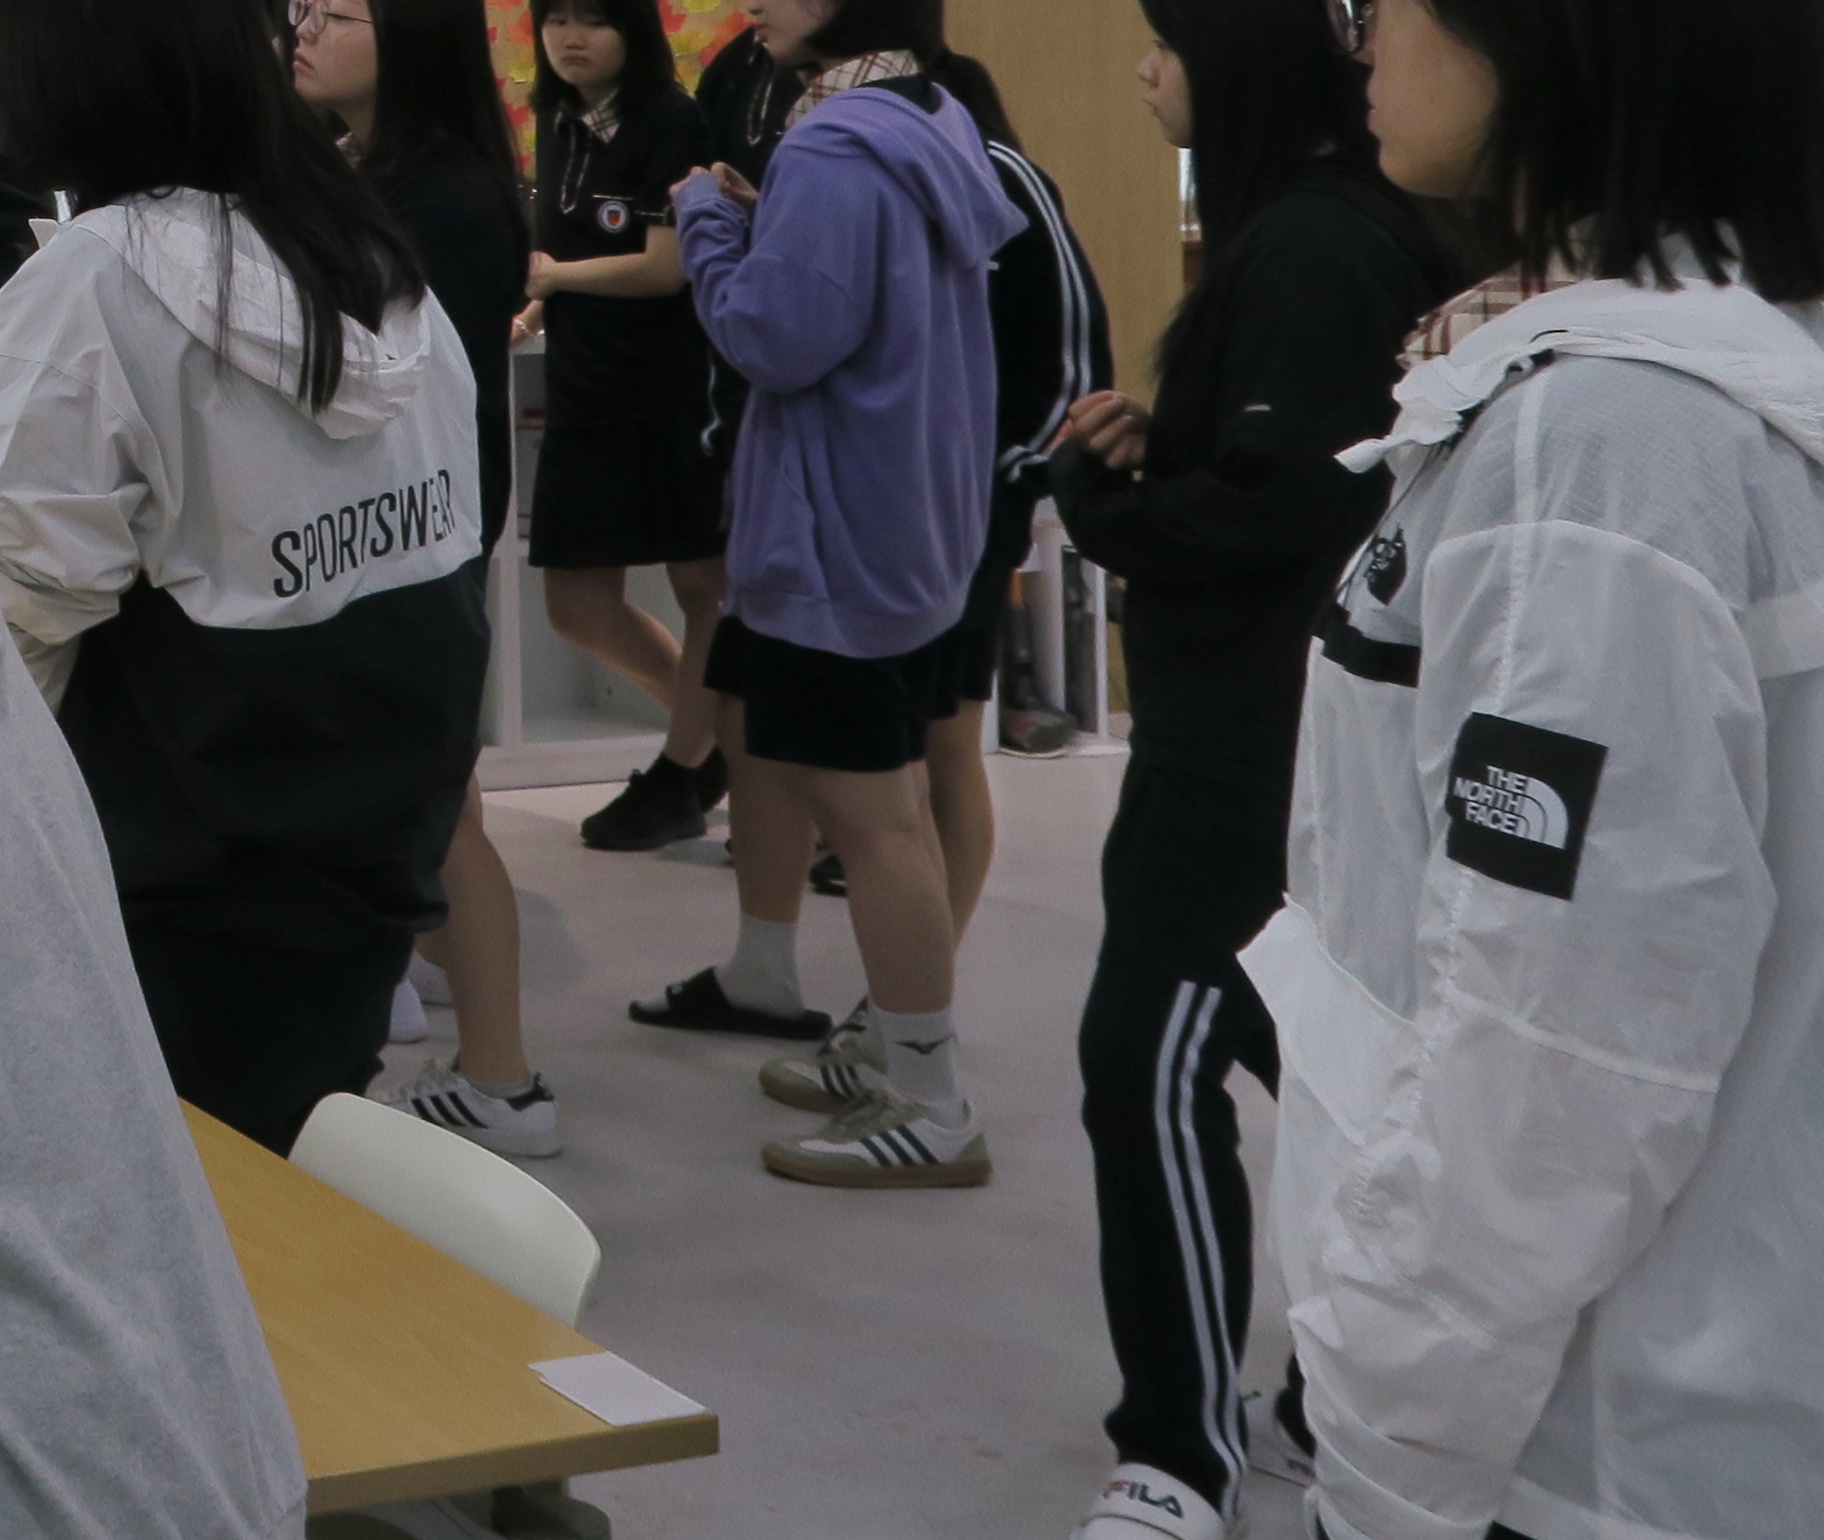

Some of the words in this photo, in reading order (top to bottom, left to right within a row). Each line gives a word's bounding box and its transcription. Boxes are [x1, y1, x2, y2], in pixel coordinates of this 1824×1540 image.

[1454, 777, 1523, 815] NORTH
[1486, 764, 1530, 795] THE
[1465, 802, 1520, 836] FACE
[1103, 1480, 1183, 1519] FILA
